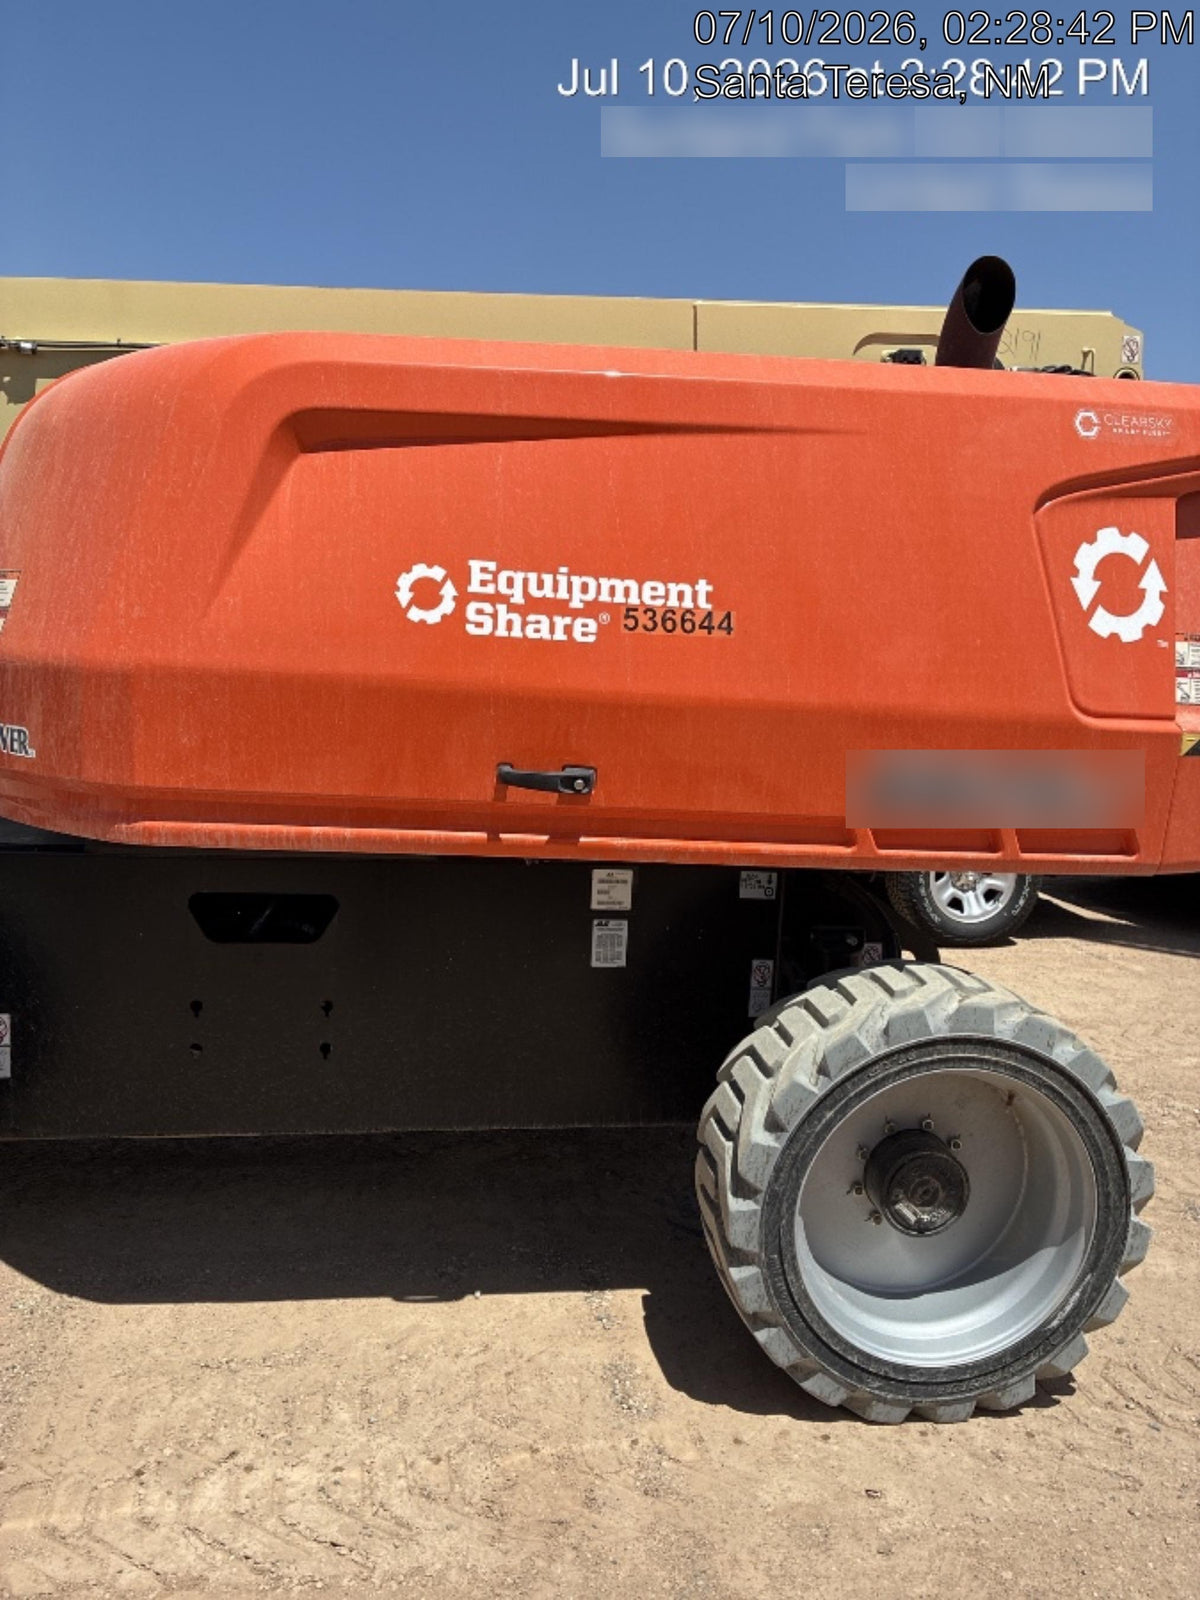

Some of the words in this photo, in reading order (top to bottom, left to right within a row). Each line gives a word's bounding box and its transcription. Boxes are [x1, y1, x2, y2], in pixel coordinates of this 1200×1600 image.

[467, 559, 713, 609] Equipment
[465, 601, 597, 643] Share
[622, 607, 735, 637] 536644
